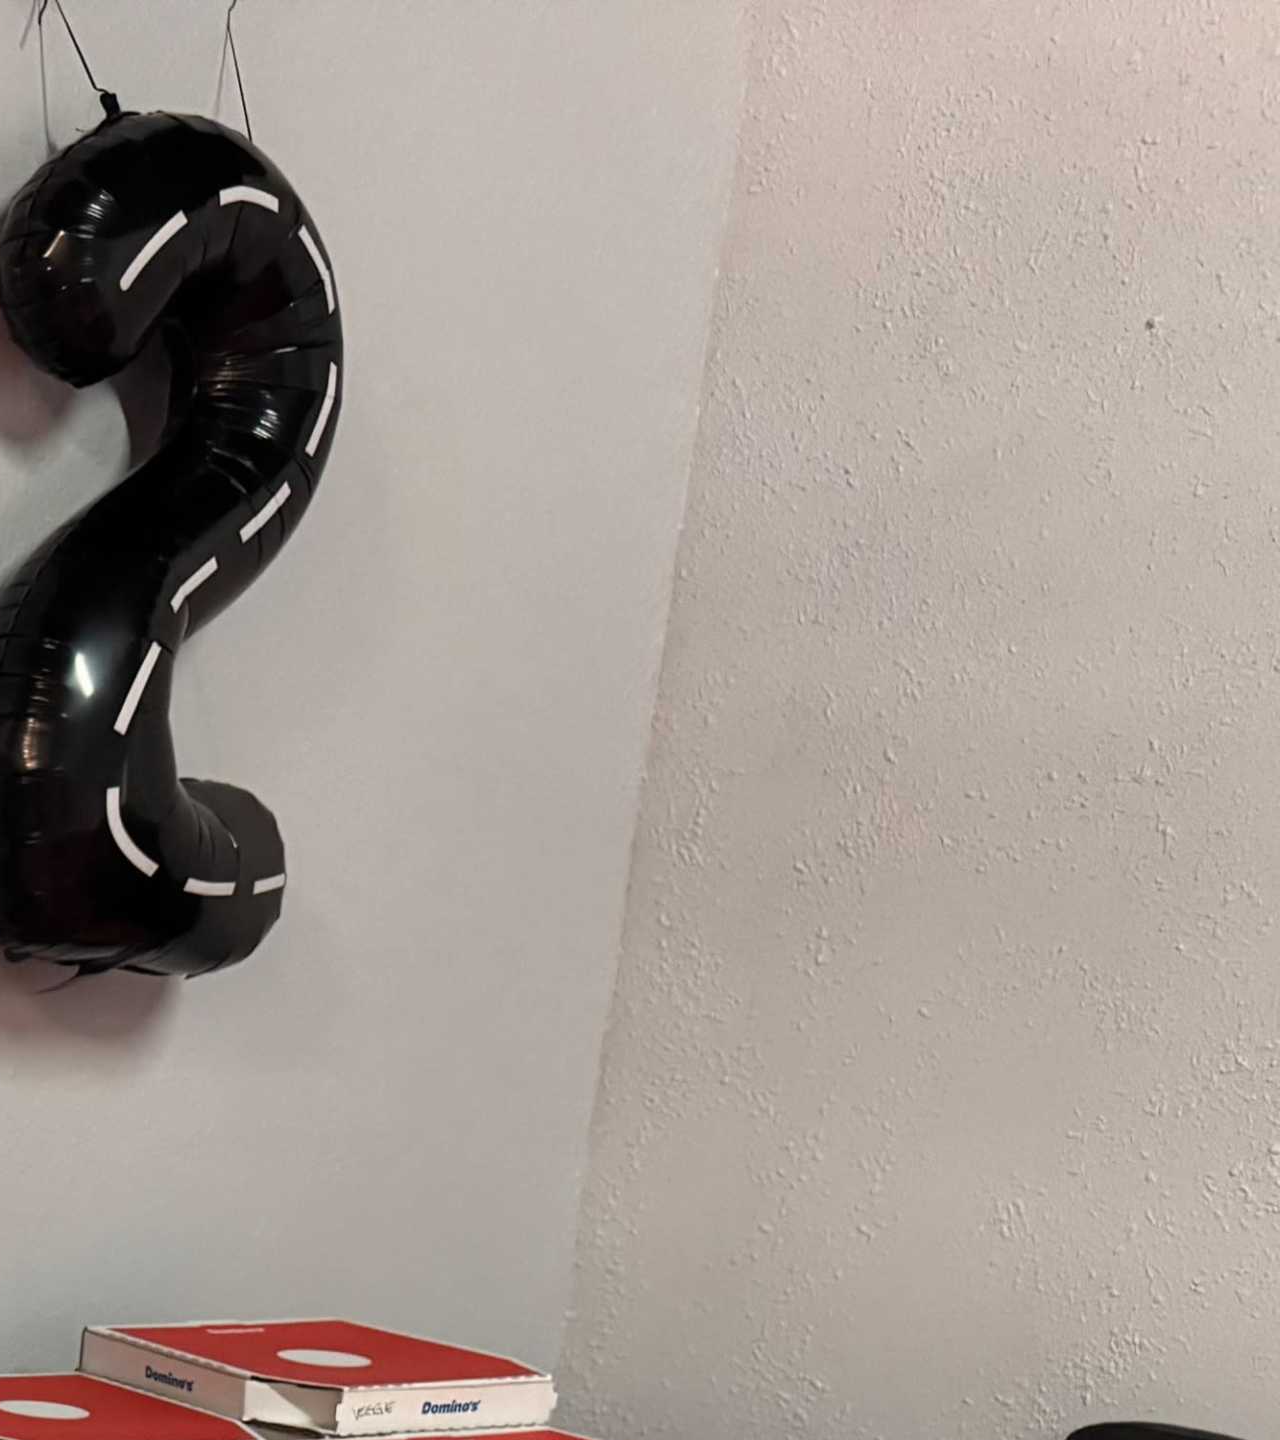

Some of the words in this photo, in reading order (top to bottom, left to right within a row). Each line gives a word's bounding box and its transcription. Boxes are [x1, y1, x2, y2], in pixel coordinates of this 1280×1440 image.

[144, 1366, 194, 1392] Domino's
[352, 1400, 397, 1421] VEGGIE
[421, 1399, 482, 1416] Domino's
